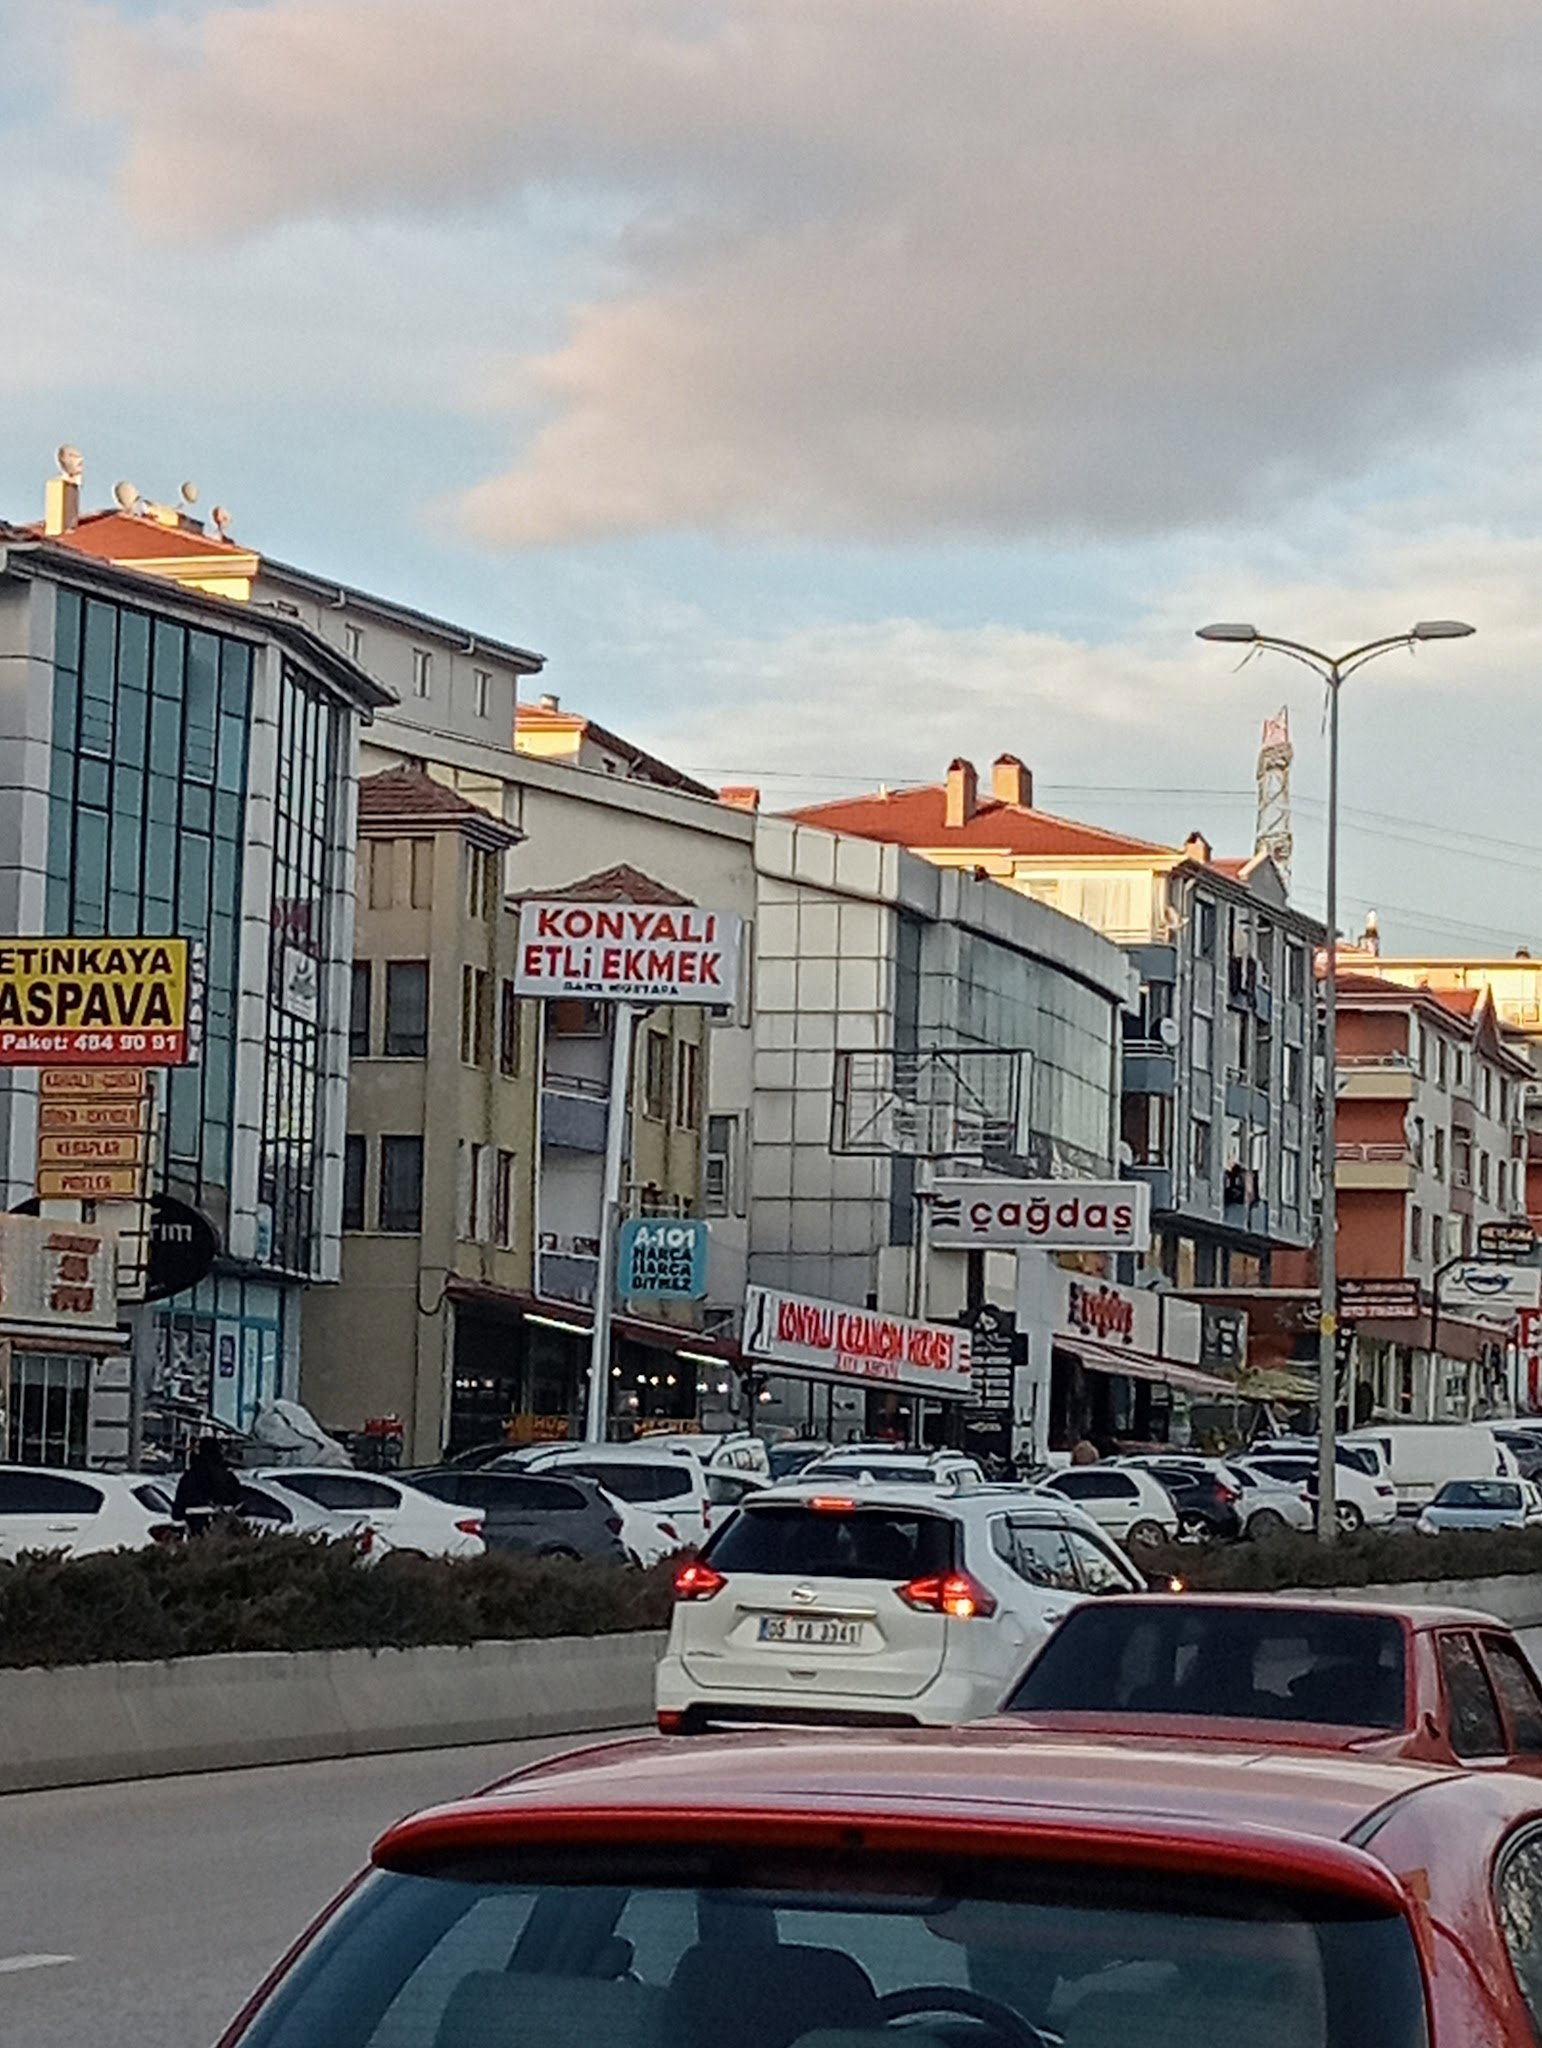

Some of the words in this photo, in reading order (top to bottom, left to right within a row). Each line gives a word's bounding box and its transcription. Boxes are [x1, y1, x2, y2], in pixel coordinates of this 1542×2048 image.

[538, 908, 716, 944] KONYALI
[601, 948, 721, 985] EKMEK
[0, 982, 173, 1026] ASPAVA
[969, 1196, 1132, 1236] çağdaş
